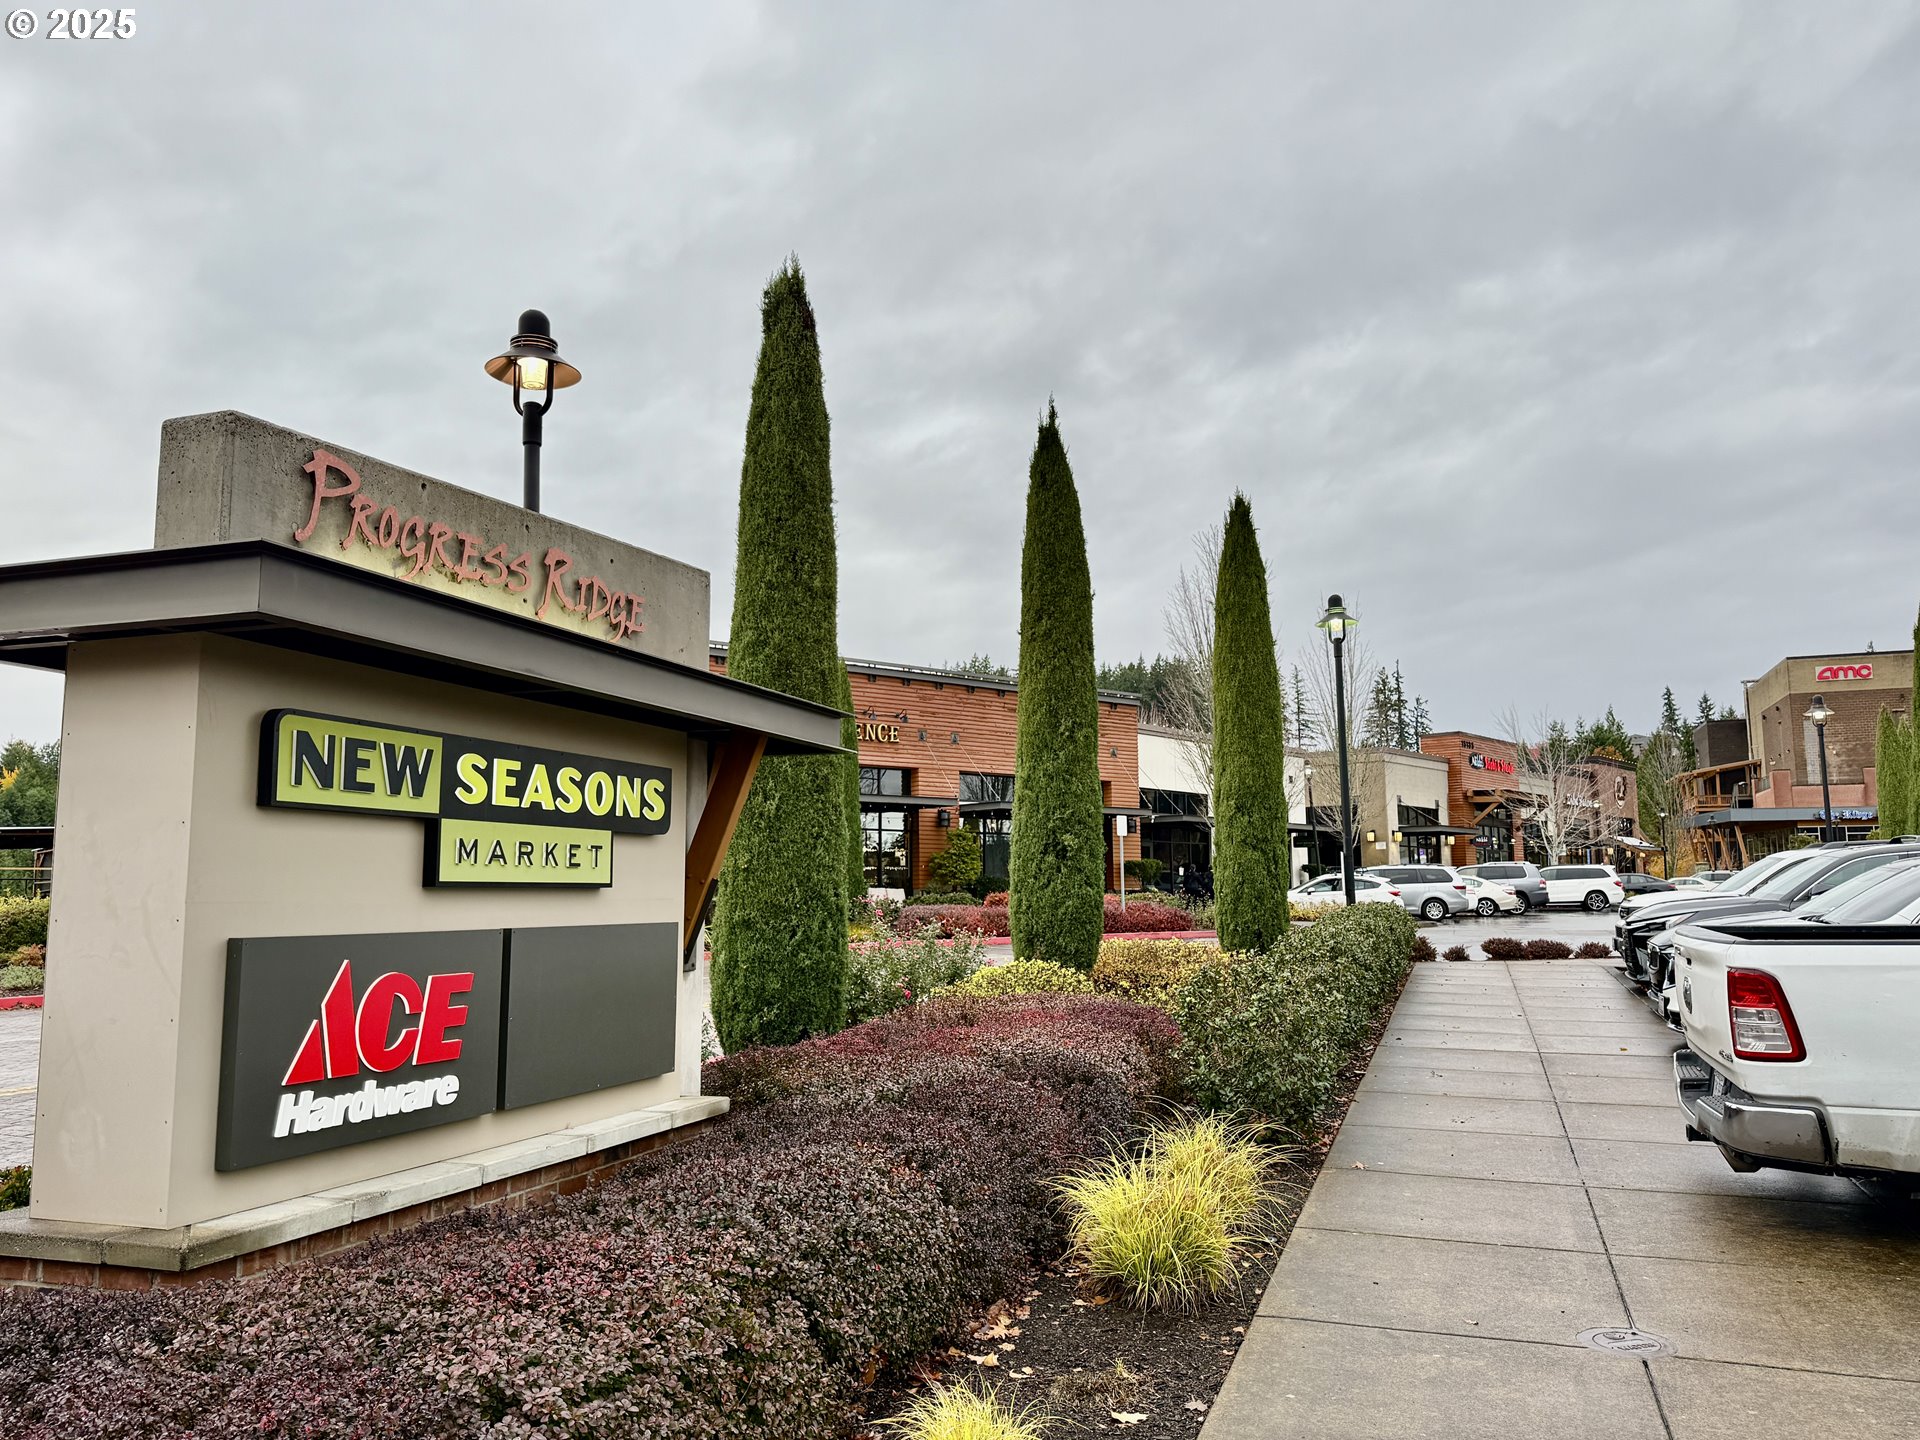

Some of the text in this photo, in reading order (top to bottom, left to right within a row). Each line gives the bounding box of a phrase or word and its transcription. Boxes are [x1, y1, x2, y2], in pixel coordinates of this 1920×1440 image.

[291, 728, 666, 822] NEW SEASONS
[455, 837, 603, 869] MARKET
[281, 959, 475, 1086] ACE
[273, 1074, 460, 1138] Hardware
